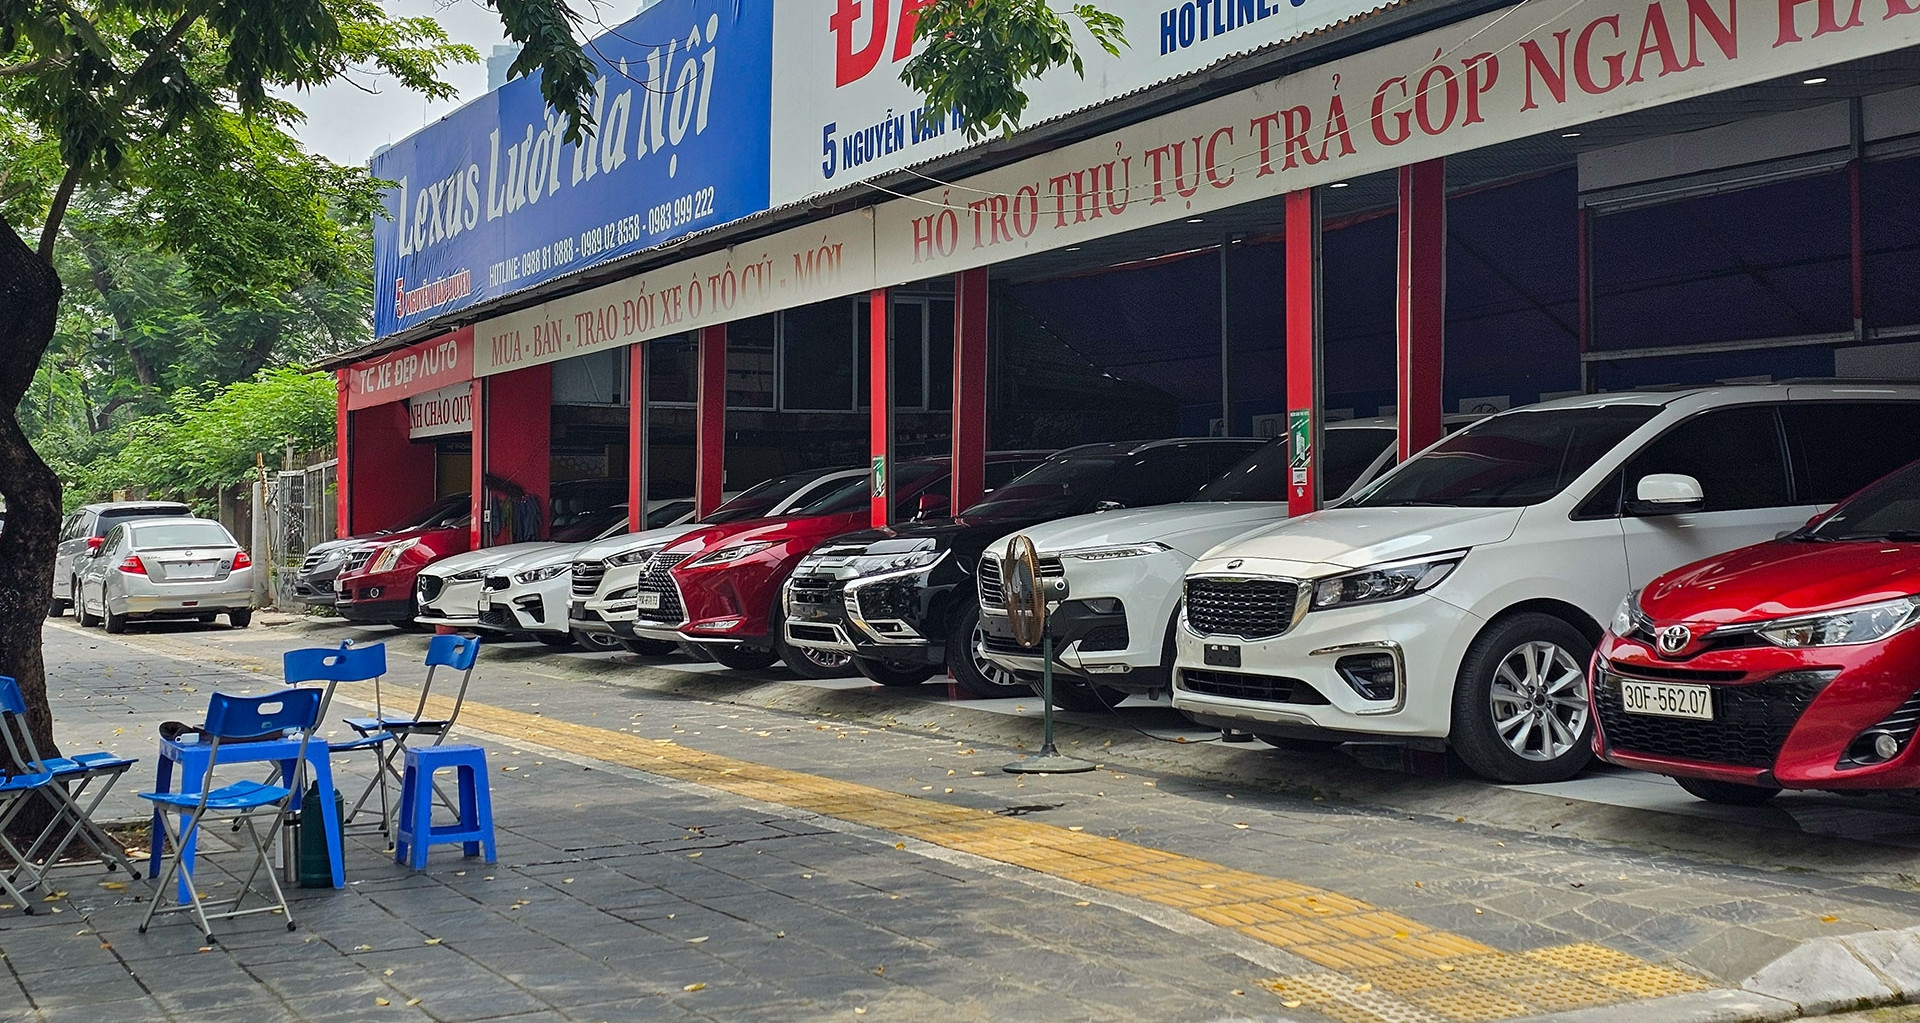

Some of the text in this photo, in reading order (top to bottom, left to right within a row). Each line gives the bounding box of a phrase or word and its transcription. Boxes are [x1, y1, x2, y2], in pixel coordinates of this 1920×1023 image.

[399, 163, 480, 259] Lexus
[637, 13, 718, 179] Nội
[821, 121, 837, 180] 5
[842, 108, 905, 171] NGUYỄN
[911, 188, 959, 265] HỖ
[1049, 140, 1132, 230] THỦ
[1144, 126, 1236, 210] TỤC
[1250, 73, 1357, 179] TRẢ
[1370, 47, 1499, 146] GÓP
[489, 186, 714, 288] HOTLINE: 0988 81 8888 0989 02 8558 0983 999 222
[395, 277, 405, 319] 5
[491, 329, 523, 367] MUA
[533, 313, 563, 358] BÁN
[575, 303, 619, 348] TRAO
[622, 280, 656, 338] ĐỔI
[660, 285, 683, 327] XE
[687, 271, 703, 320] Ô
[707, 260, 737, 315] TÔ
[793, 234, 843, 293] MỚI
[360, 340, 458, 395] TC XE ĐẸP AUTO
[424, 391, 450, 427] CHÀO
[1625, 685, 1707, 715] 30F-562.07
